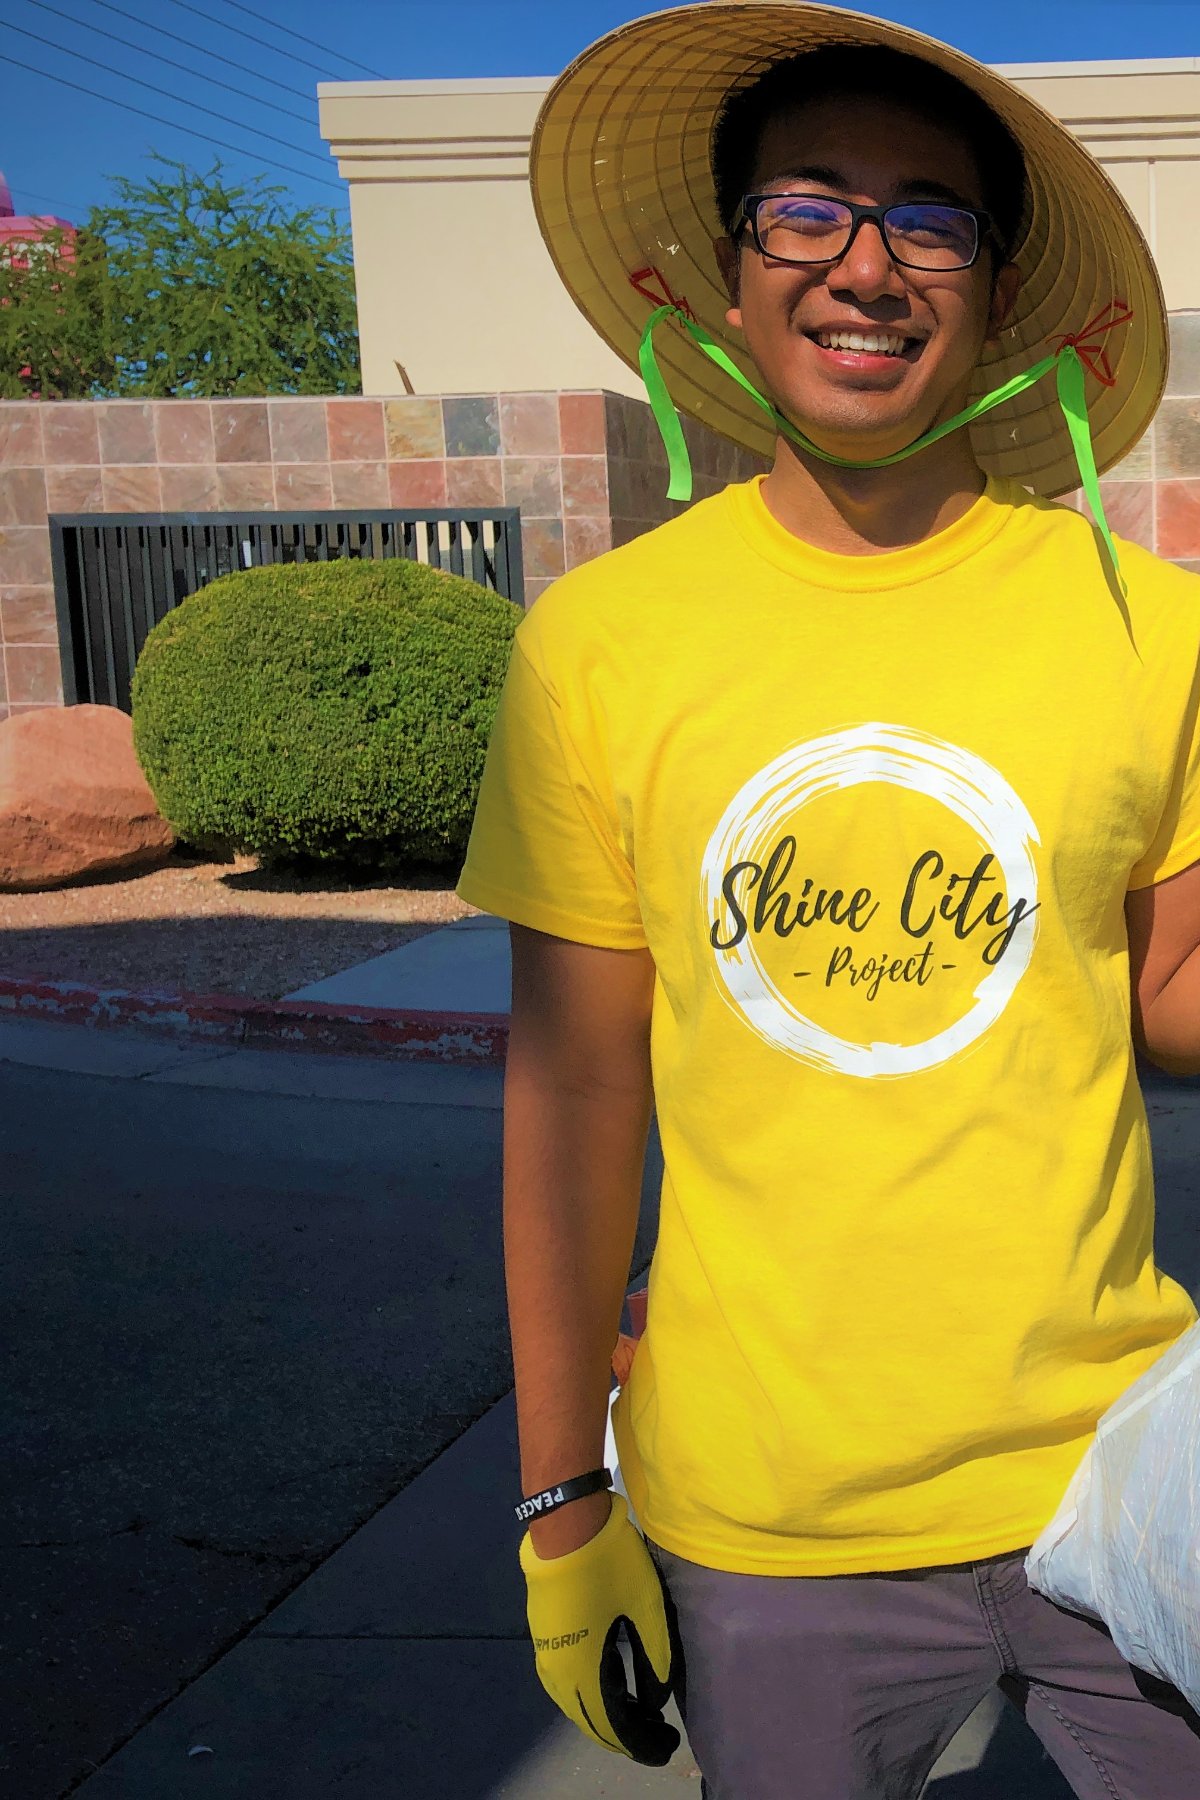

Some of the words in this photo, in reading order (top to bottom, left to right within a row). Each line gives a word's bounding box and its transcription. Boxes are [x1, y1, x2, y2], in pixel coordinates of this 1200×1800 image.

[709, 835, 880, 950] Shine
[900, 850, 1042, 966] City
[825, 941, 934, 1001] Project
[551, 1629, 589, 1650] GRIP
